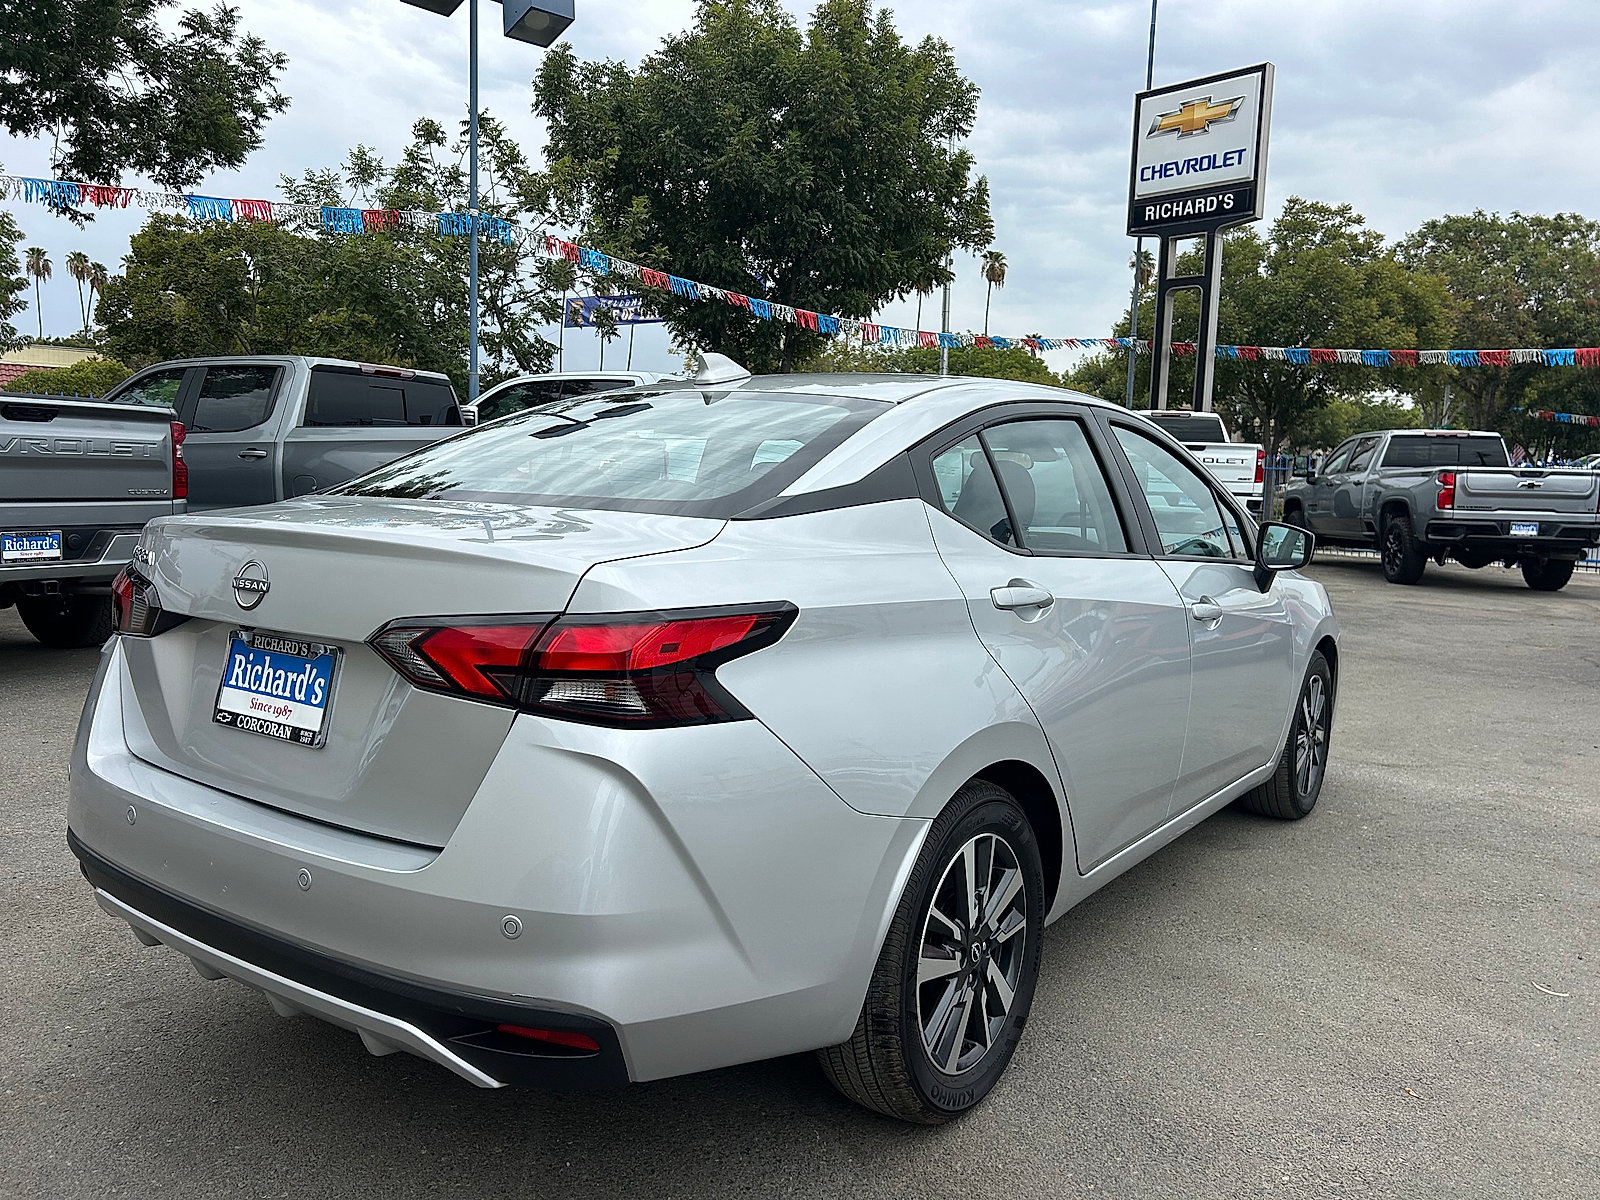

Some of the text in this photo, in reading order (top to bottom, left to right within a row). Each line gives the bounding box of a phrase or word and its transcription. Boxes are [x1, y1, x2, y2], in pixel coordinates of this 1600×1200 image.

[1140, 148, 1247, 182] CHEVROLET
[1145, 193, 1234, 221] RICHARD'S
[1198, 457, 1248, 465] OLET
[4, 537, 58, 550] Richard's
[233, 579, 268, 591] NISSAN
[253, 635, 308, 656] RICHARD'S
[229, 652, 325, 705] Richard's
[249, 697, 292, 720] Since 1987
[237, 715, 292, 739] CORCORAN
[931, 1084, 975, 1108] KUMHO
